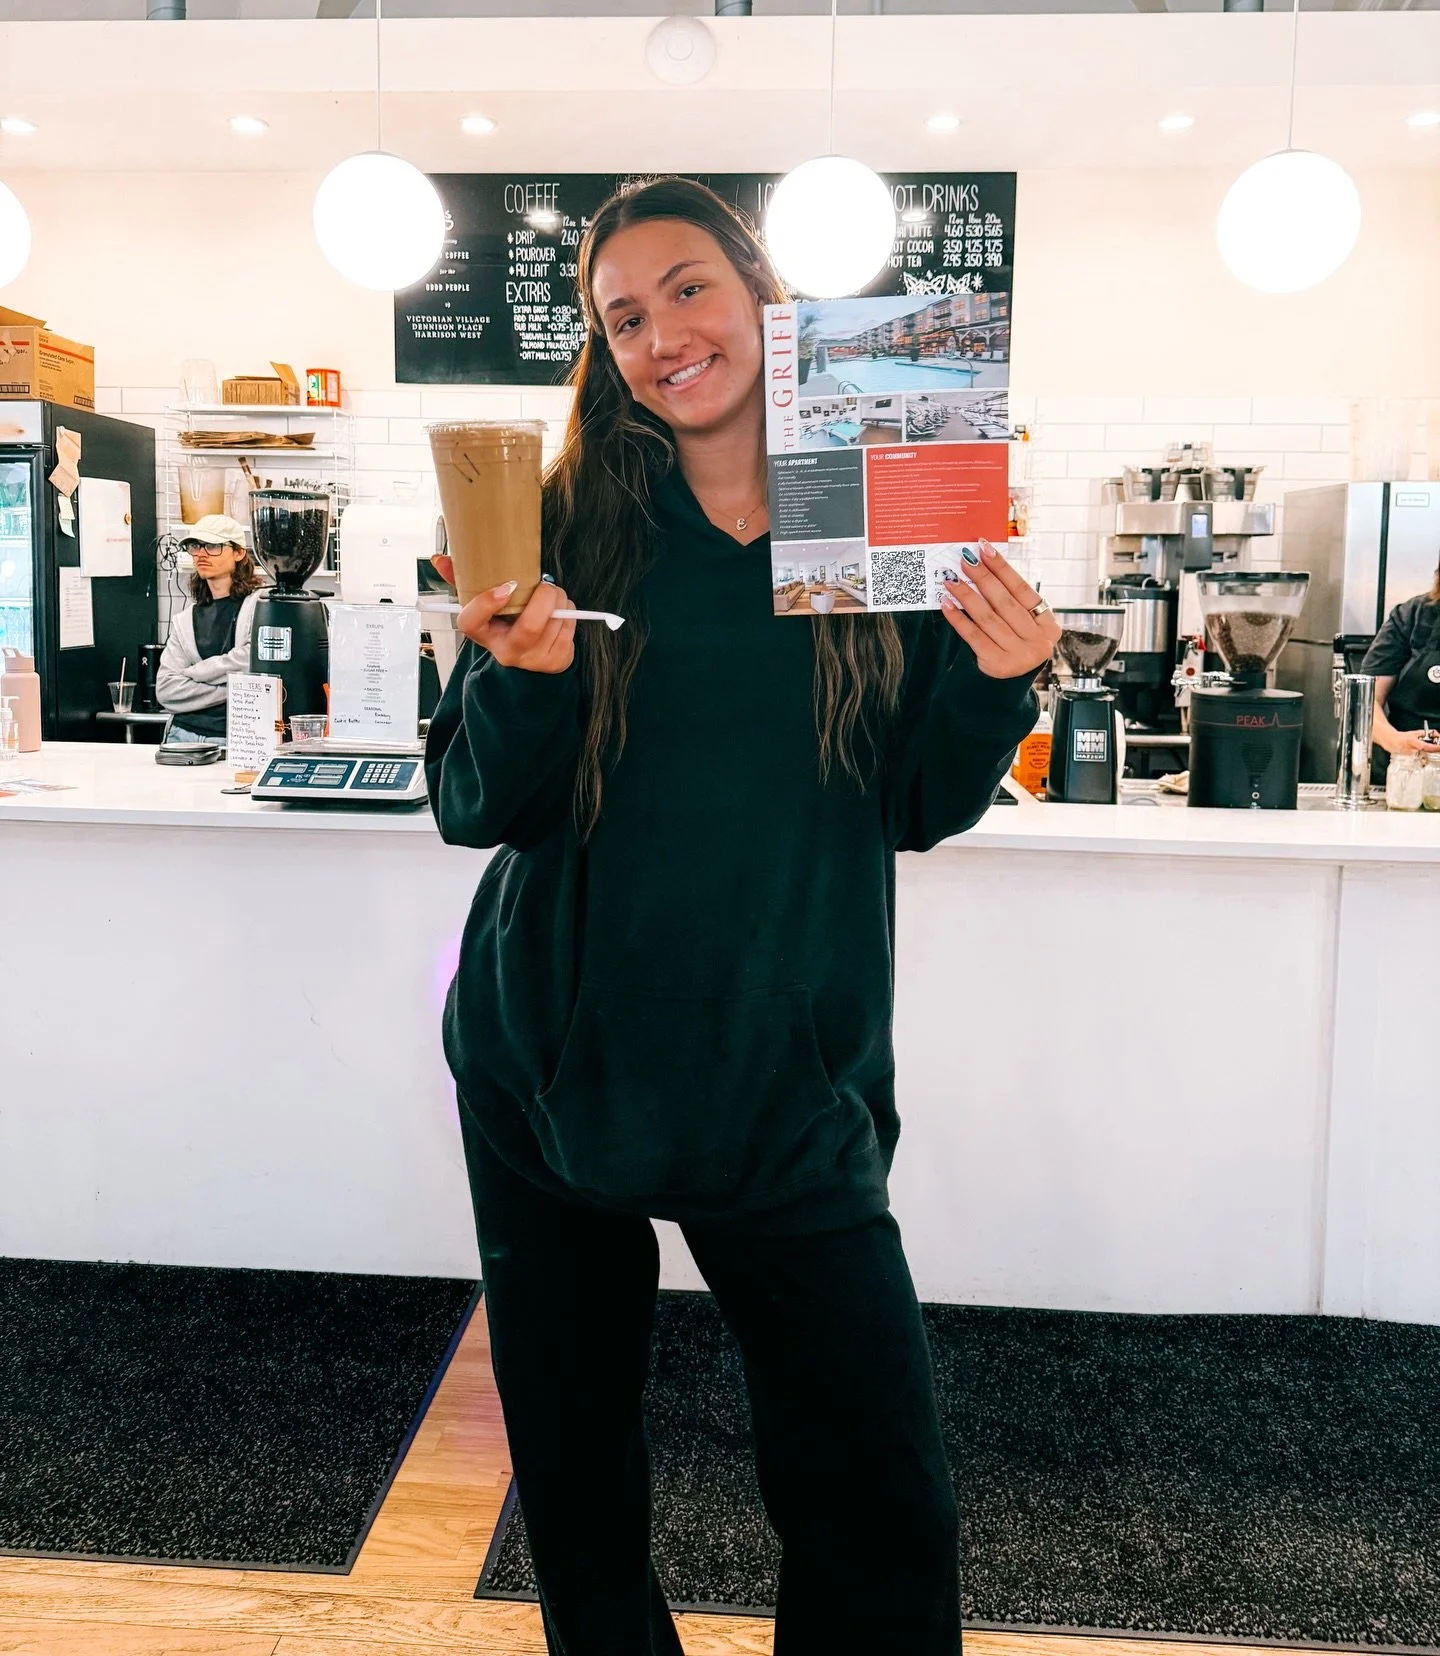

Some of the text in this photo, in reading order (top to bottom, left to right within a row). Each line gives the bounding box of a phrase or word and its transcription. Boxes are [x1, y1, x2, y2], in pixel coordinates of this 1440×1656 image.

[504, 183, 561, 214] COFFEE
[923, 184, 979, 212] DRINKS
[909, 225, 932, 237] LATTE
[944, 224, 963, 237] 4.60
[965, 225, 983, 237] 5.30
[984, 224, 1003, 237] 5.65
[515, 229, 579, 246] DRIP 2.60
[893, 239, 1003, 253] OT COCOA 3.50 4.25 4.75
[445, 251, 469, 259] COFFEE
[515, 247, 556, 262] POUROVER
[906, 255, 922, 267] TEA
[942, 253, 962, 267] 2.95
[964, 253, 982, 267] 3.50
[984, 252, 1002, 267] 3.90
[515, 263, 578, 277] AU LAIT 3.30
[445, 283, 470, 292] PEOPLE
[505, 282, 551, 303] EXTRAS
[513, 305, 532, 314] EXTRA
[533, 305, 548, 314] SHOT
[406, 315, 491, 324] VICTORIAN VILLAGE
[514, 314, 526, 322] ADD
[528, 314, 549, 322] FLAVOR
[412, 323, 483, 331] DENNISON PLACE
[514, 323, 526, 331] SUB
[528, 323, 542, 331] MILK
[415, 330, 482, 339] HARRISON WEST
[522, 352, 535, 360] OAT
[536, 352, 550, 360] MILK
[771, 310, 794, 408] GRIFF
[784, 415, 794, 451] THE
[774, 458, 818, 467] YOUR APARTMENT
[884, 452, 917, 460] COMMUNITY
[1236, 715, 1265, 728] PEAK
